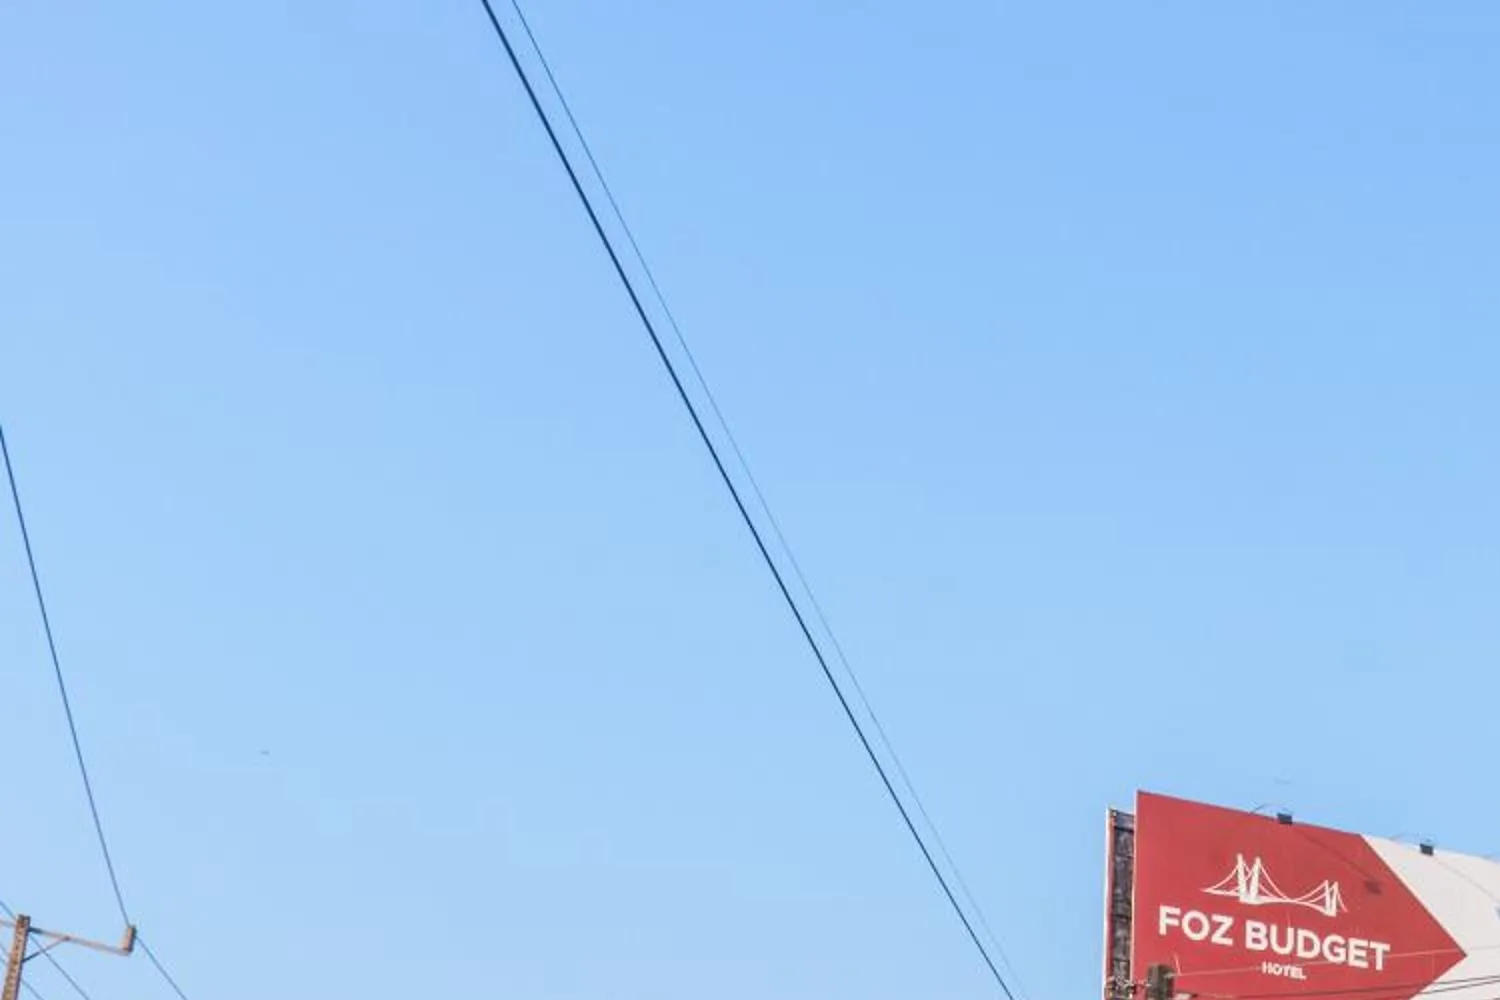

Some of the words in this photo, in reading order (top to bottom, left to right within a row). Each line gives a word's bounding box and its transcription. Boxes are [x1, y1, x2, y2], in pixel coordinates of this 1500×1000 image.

[1159, 905, 1234, 946] FOZ
[1245, 920, 1391, 971] BUDGET
[1262, 961, 1307, 980] HOTEL
